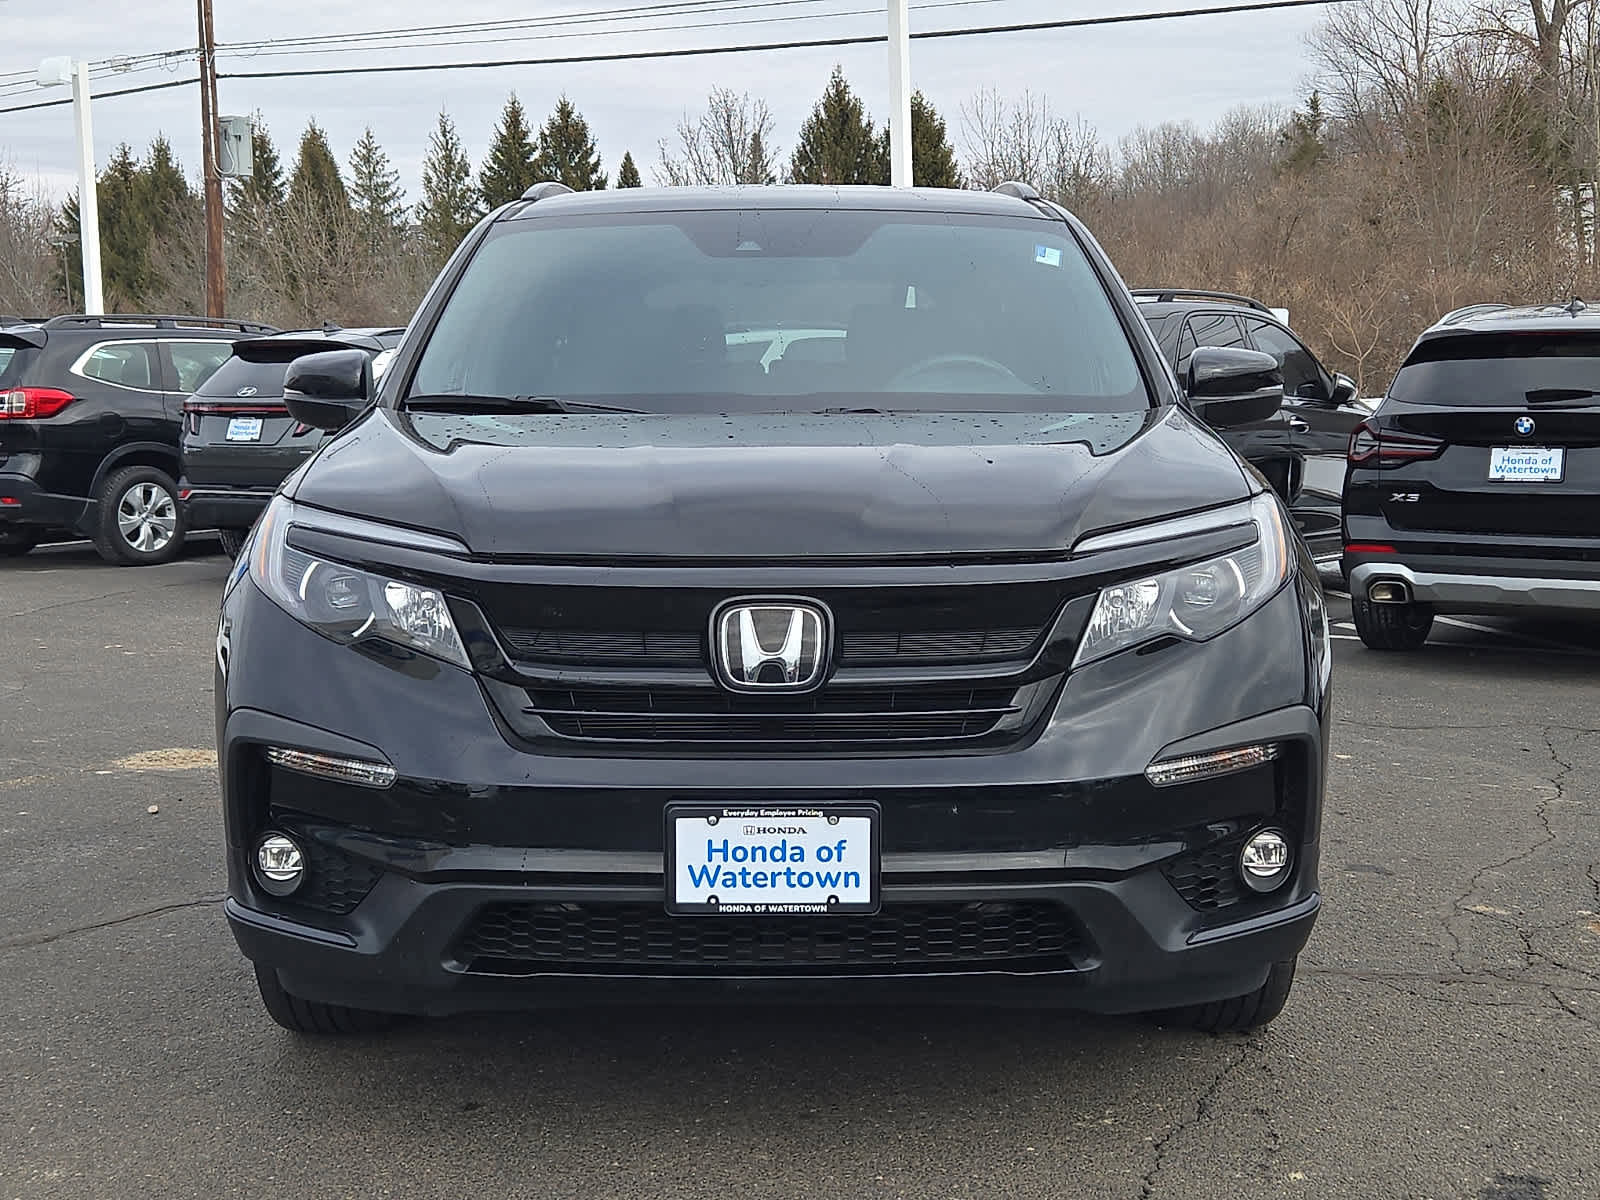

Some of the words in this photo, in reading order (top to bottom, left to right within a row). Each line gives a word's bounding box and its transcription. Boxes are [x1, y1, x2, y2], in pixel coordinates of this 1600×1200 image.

[1502, 455, 1538, 465] Honda
[1541, 456, 1552, 465] of
[1494, 464, 1557, 474] Watertown
[1389, 493, 1420, 502] X3
[723, 809, 759, 817] Everyday
[760, 809, 796, 817] Employee
[797, 809, 823, 817] Pricing
[707, 839, 805, 863] Honda
[816, 839, 848, 863] of
[687, 864, 860, 889] Watertown
[719, 905, 752, 913] HONDA
[754, 905, 767, 913] OF
[769, 905, 828, 913] WATERTOWN
